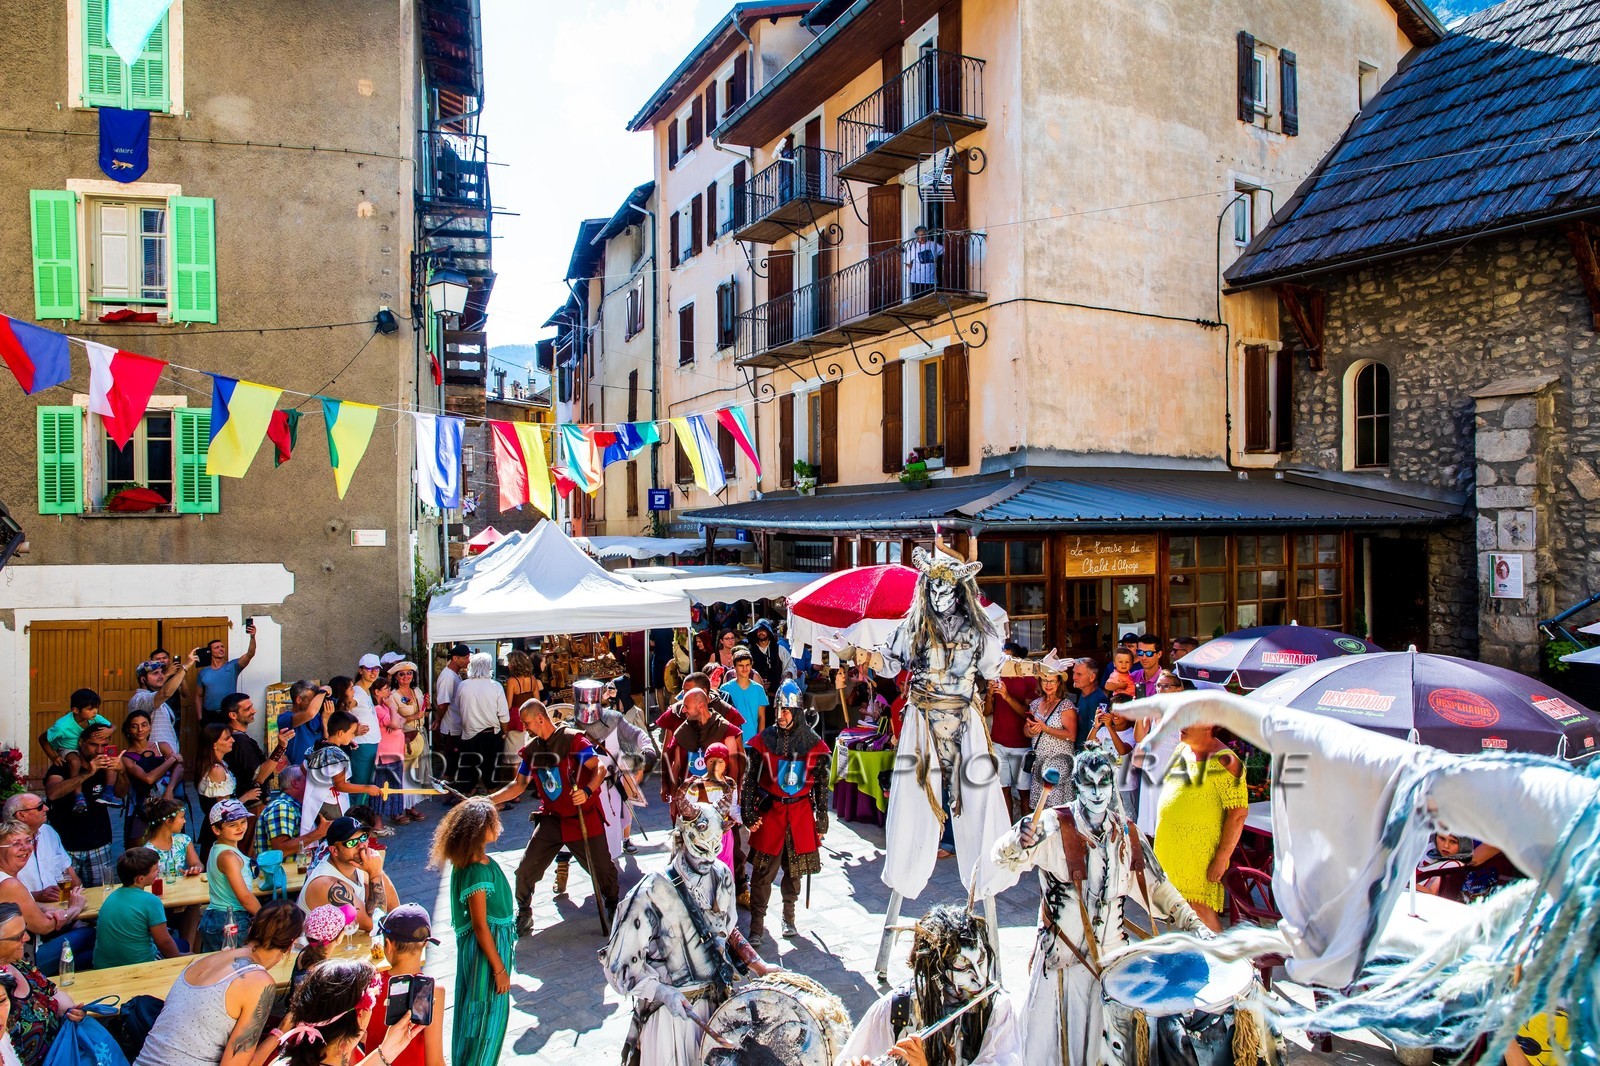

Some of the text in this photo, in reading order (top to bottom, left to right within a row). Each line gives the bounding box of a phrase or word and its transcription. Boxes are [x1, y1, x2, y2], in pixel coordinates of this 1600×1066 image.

[1082, 557, 1109, 573] Chalet
[1262, 652, 1317, 665] DESPERADOS
[1318, 690, 1395, 711] DESPERADOS
[1435, 697, 1492, 717] DESPERADOS
